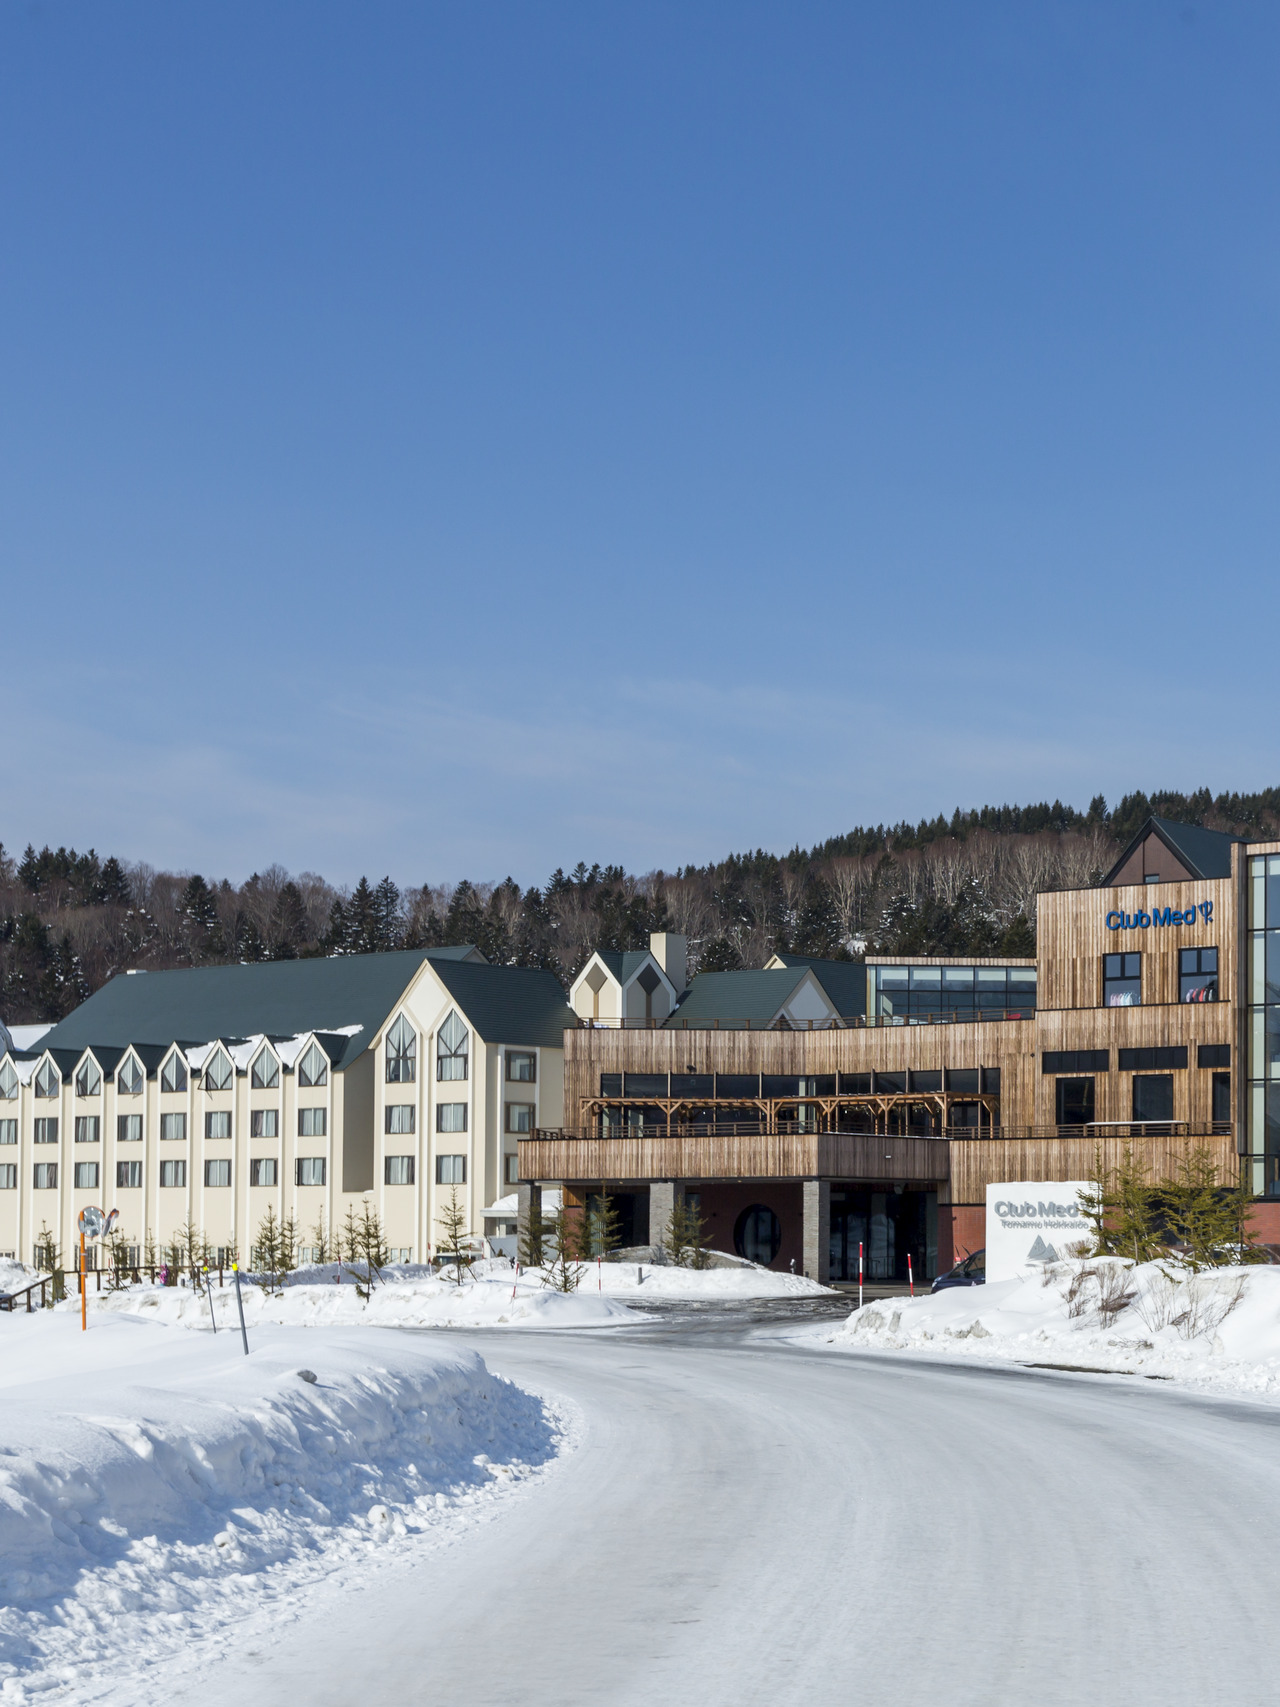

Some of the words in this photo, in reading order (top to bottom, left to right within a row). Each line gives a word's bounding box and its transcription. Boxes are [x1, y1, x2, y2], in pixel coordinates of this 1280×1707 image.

[1106, 910, 1151, 930] Club
[1152, 905, 1196, 927] Med
[994, 1201, 1037, 1218] Club
[1038, 1201, 1079, 1218] Med
[1000, 1219, 1043, 1229] Tomamu
[1043, 1219, 1089, 1229] Hokkaido
